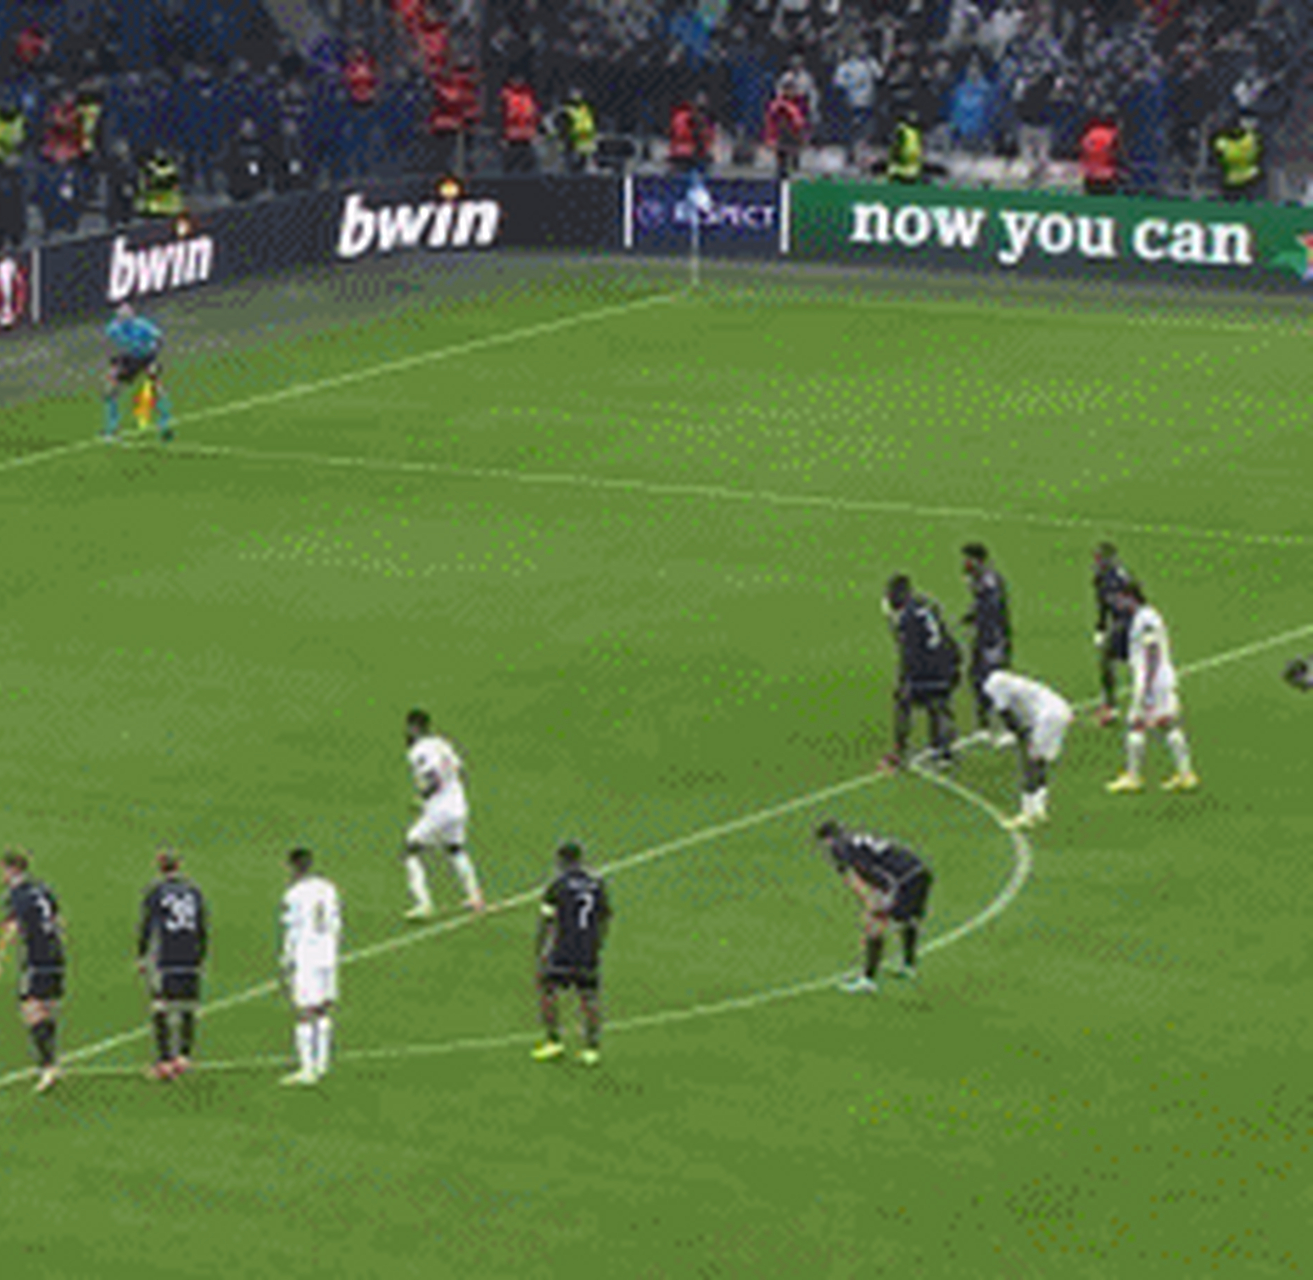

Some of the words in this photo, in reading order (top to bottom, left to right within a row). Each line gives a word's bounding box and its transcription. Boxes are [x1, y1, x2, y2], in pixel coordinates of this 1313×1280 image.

[338, 194, 498, 257] bwin
[849, 202, 984, 248] now
[998, 209, 1118, 265] you
[1132, 219, 1253, 265] can
[108, 235, 213, 300] bwin
